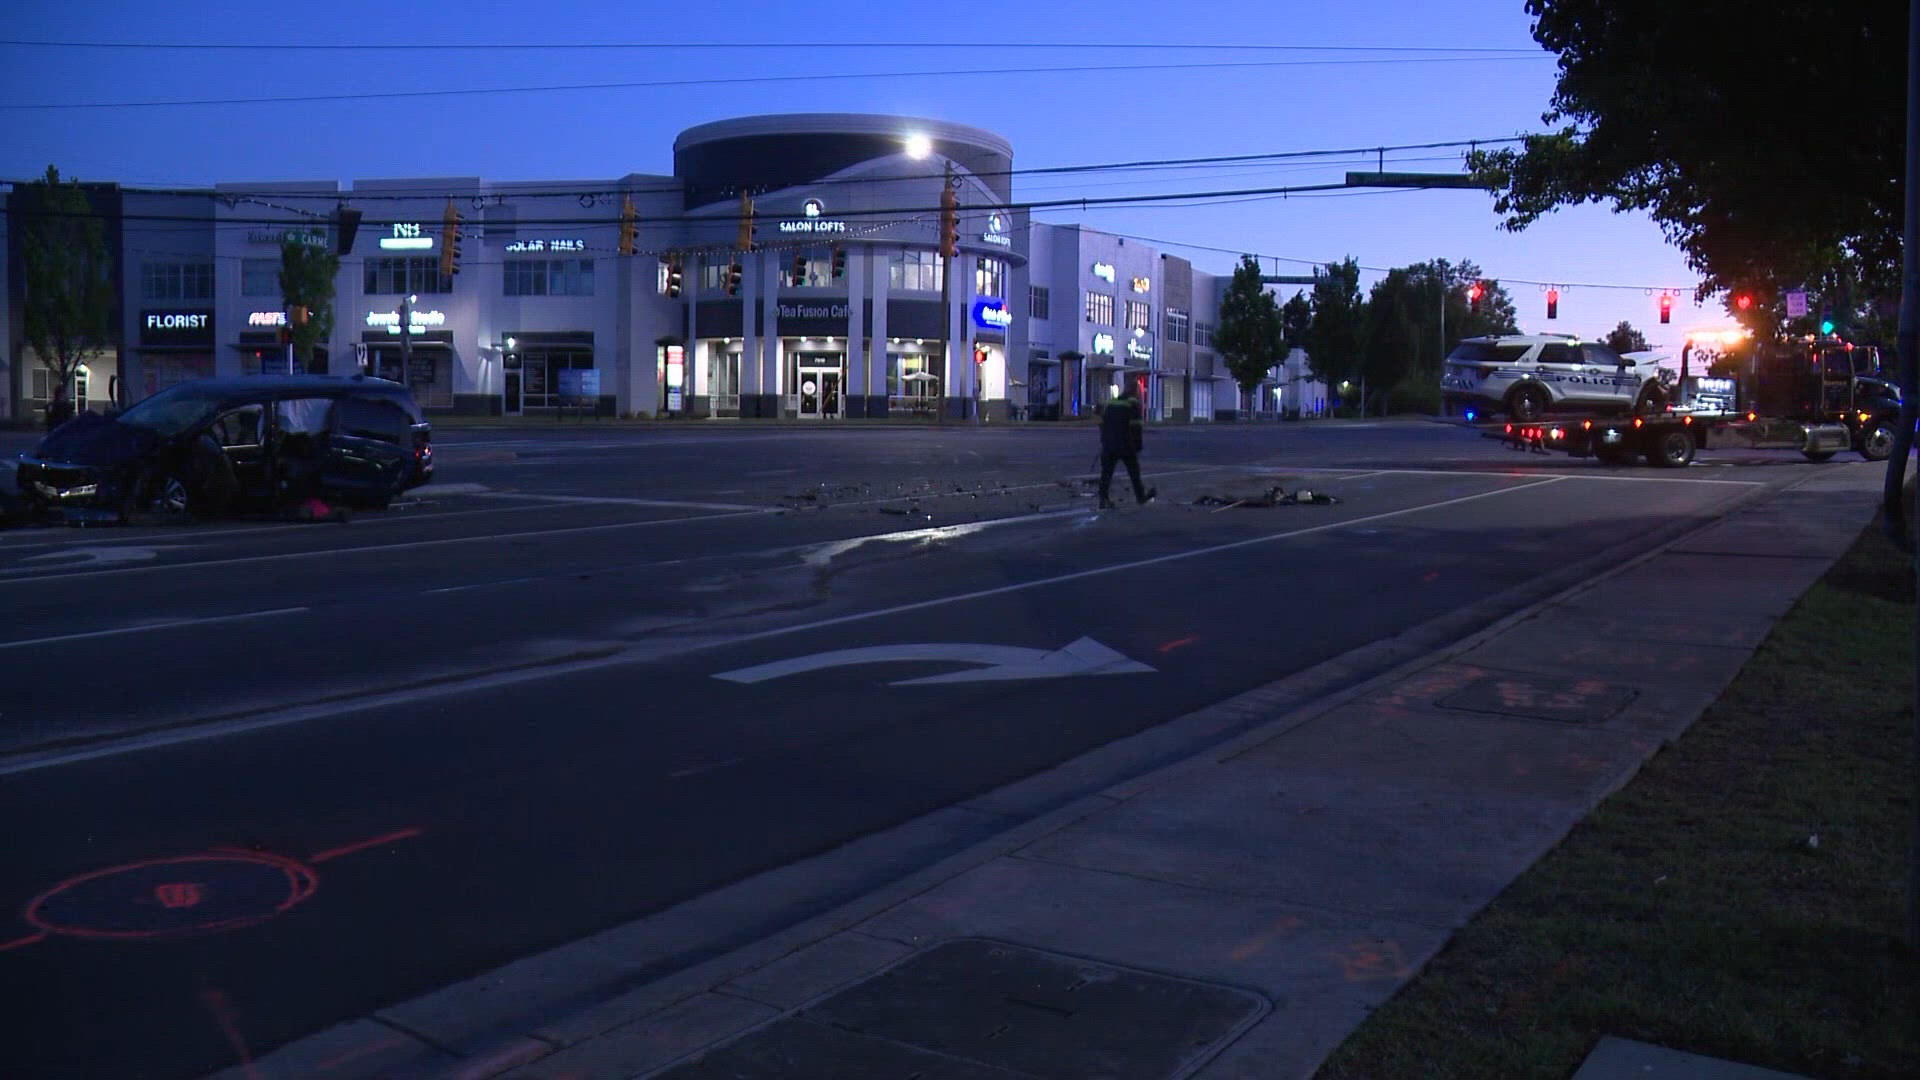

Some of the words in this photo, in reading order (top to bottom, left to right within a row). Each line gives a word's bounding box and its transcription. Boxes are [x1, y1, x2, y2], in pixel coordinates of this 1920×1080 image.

[780, 222, 812, 232] SALON
[814, 222, 846, 232] LOFTS
[983, 232, 1001, 244] SALON
[550, 239, 584, 251] NAILS
[779, 304, 797, 318] Tea
[797, 304, 829, 318] Fusion
[147, 314, 208, 328] FLORIST
[248, 311, 288, 326] FASTS
